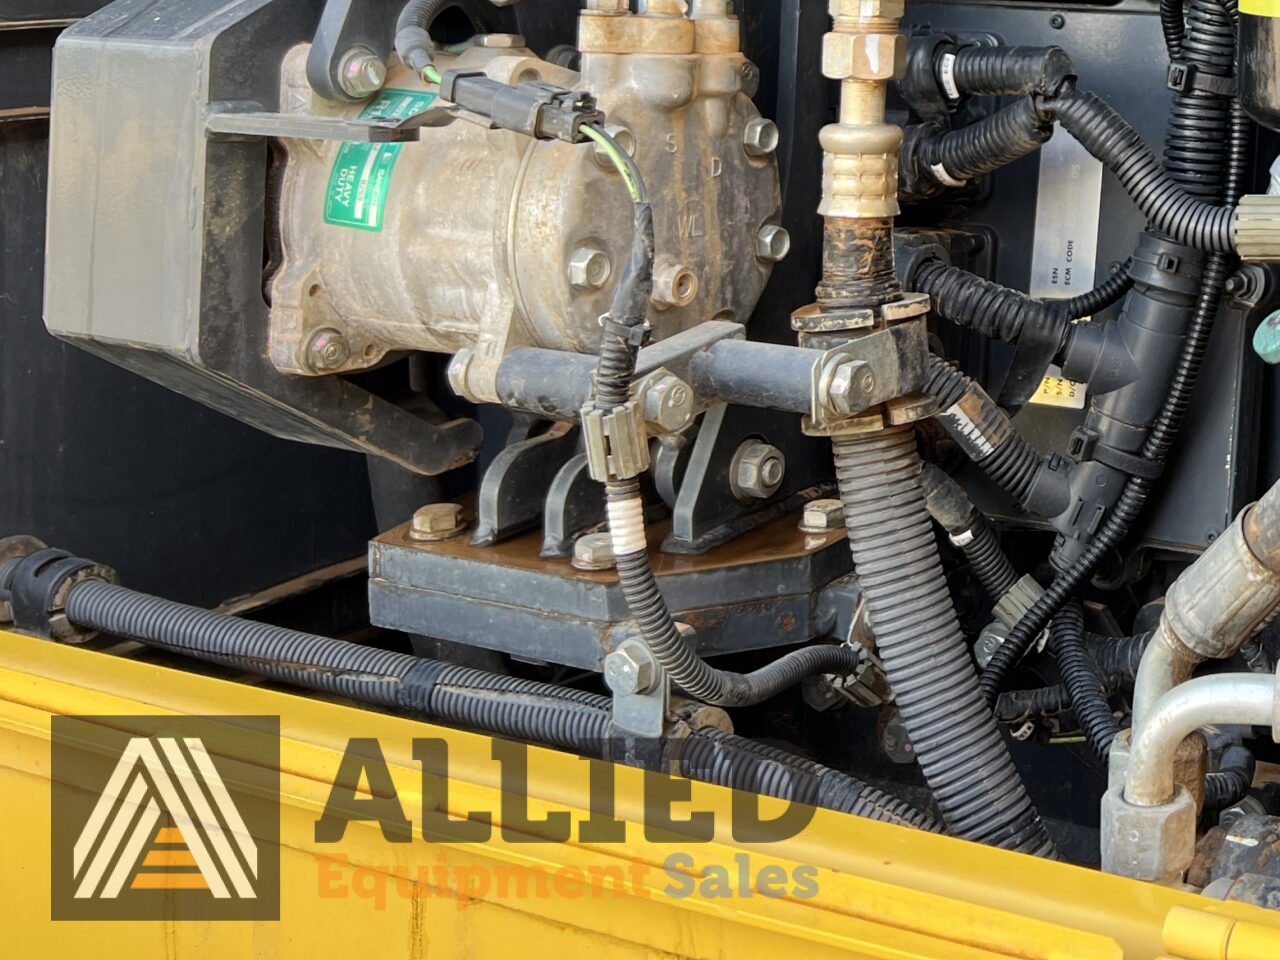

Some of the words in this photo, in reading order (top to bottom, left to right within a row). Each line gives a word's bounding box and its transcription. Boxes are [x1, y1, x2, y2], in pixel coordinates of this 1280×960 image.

[335, 168, 349, 202] DUTY
[341, 165, 358, 208] HEAVY
[1051, 267, 1059, 284] ESN
[1064, 267, 1072, 286] ECM
